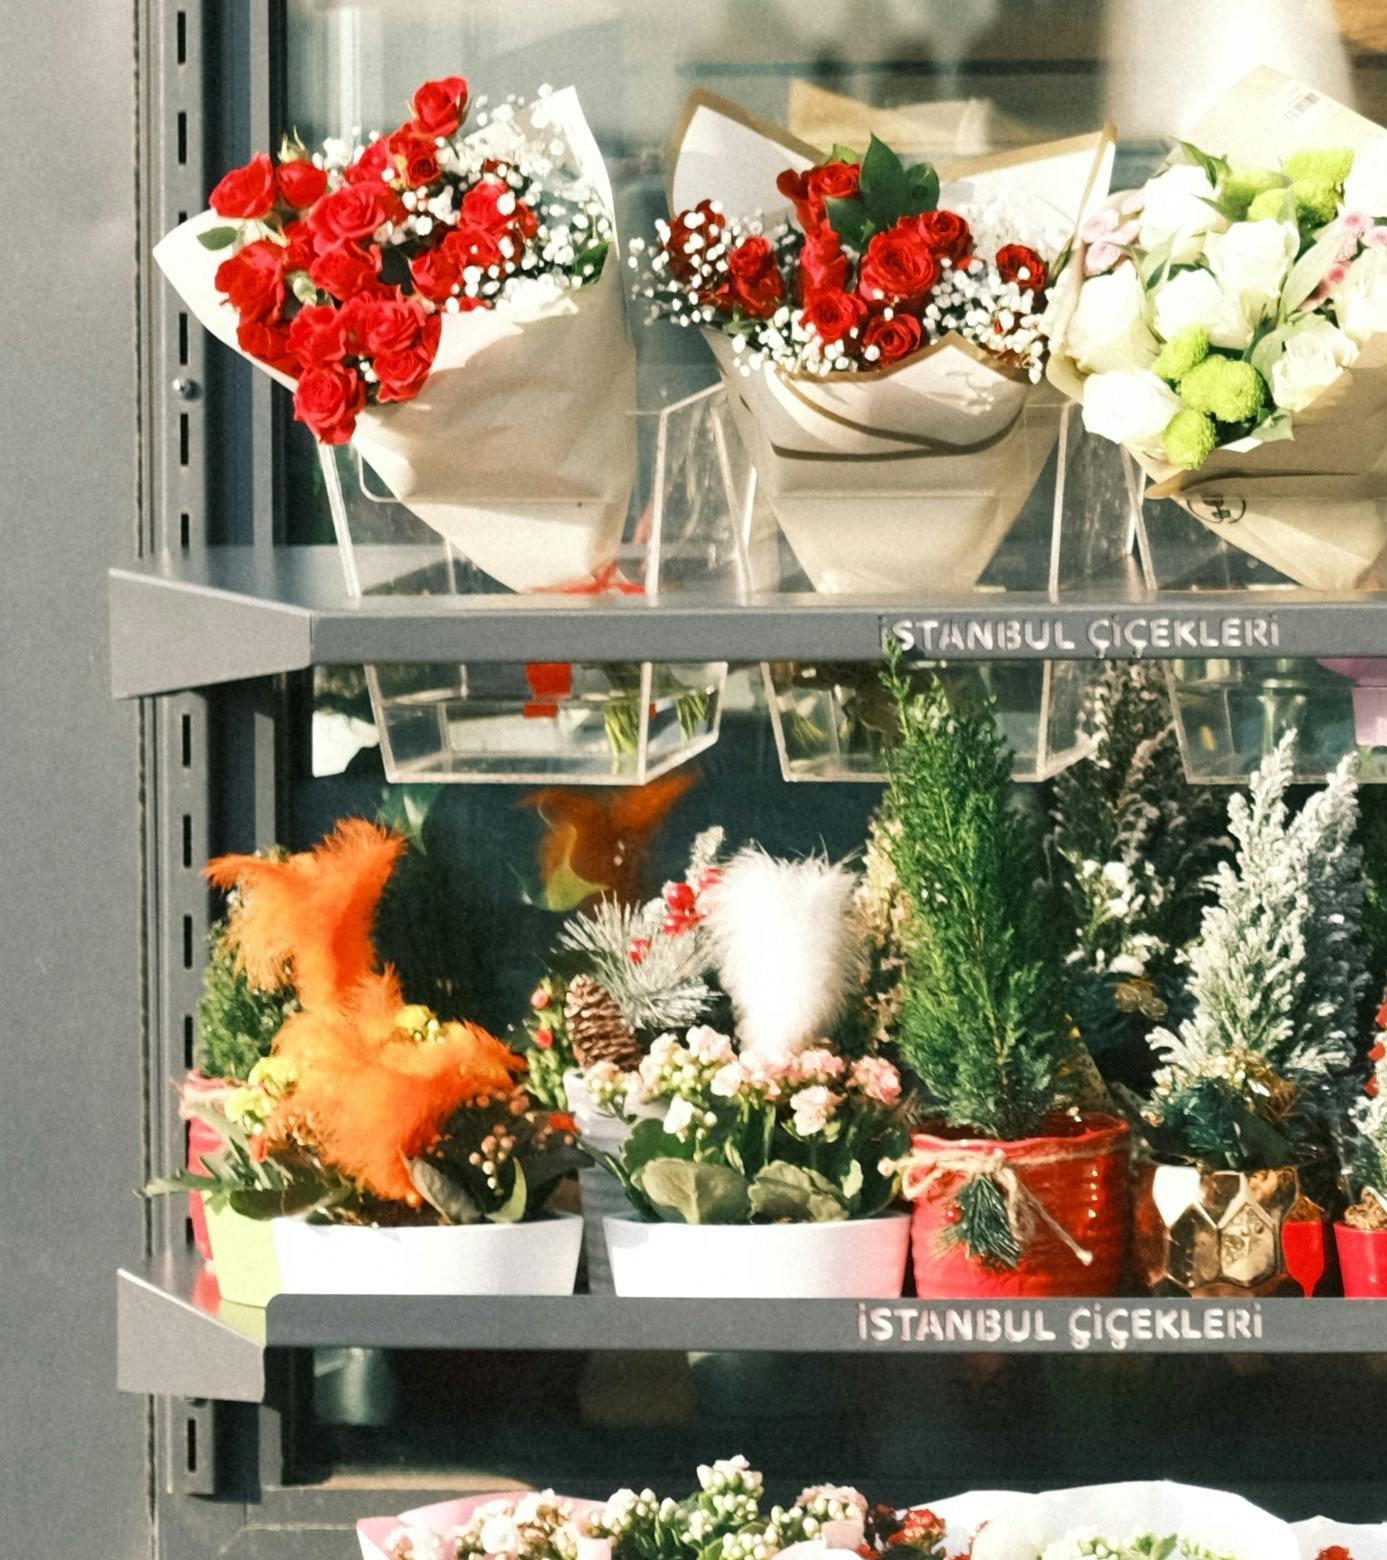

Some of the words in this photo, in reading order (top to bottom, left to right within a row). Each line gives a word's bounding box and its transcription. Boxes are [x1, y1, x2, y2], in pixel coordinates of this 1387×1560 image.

[1087, 612, 1281, 659] ÇİÇEKLERİ
[858, 1303, 1057, 1343] İSTANBUL
[1068, 1302, 1264, 1350] ÇİÇEKLERİ
